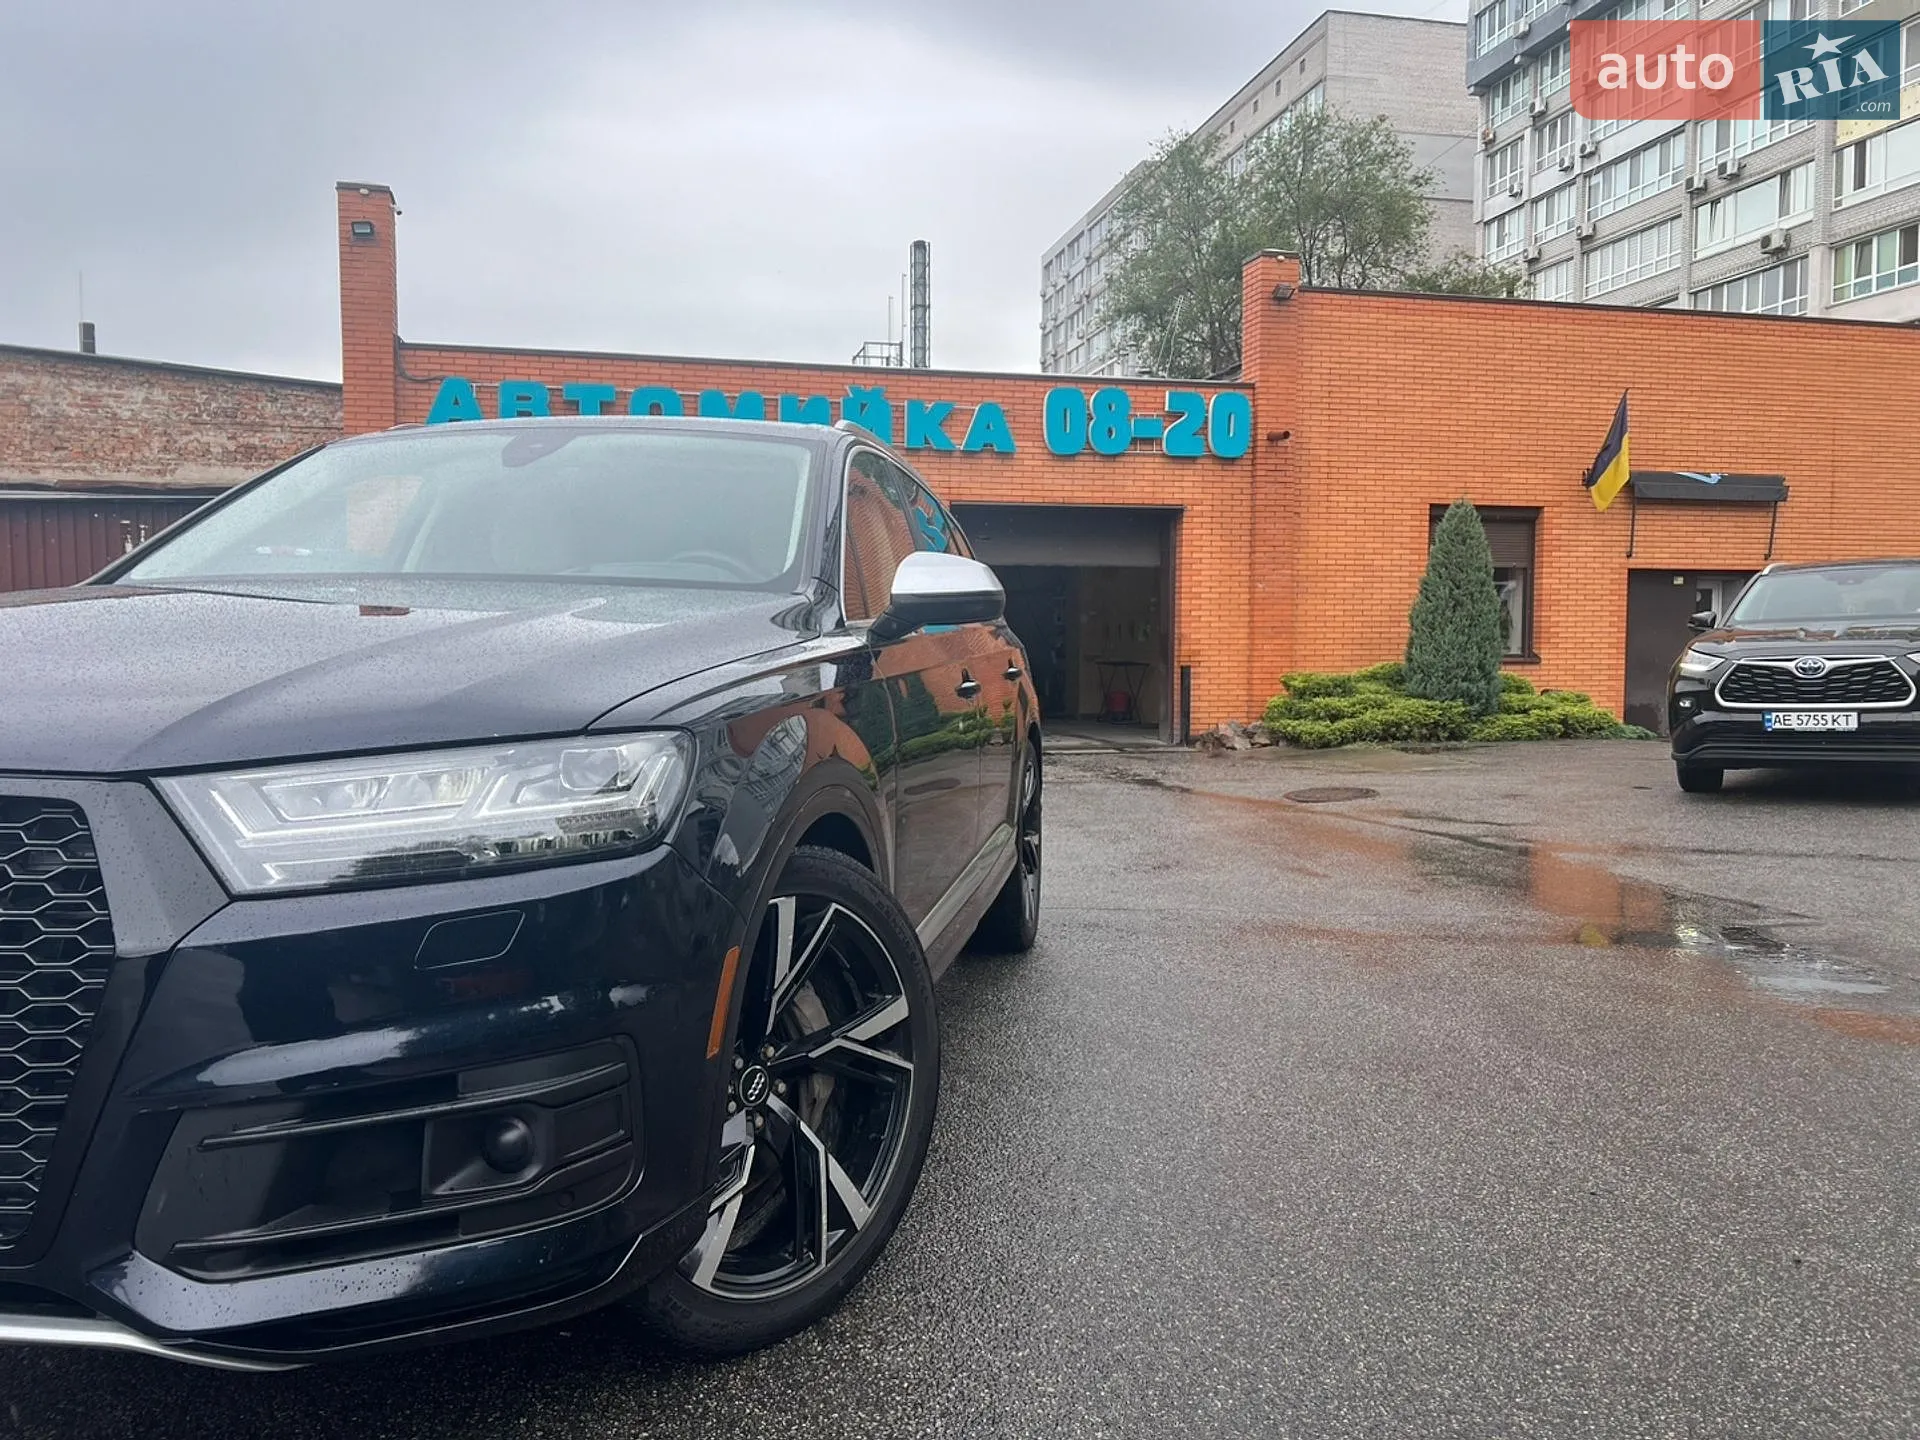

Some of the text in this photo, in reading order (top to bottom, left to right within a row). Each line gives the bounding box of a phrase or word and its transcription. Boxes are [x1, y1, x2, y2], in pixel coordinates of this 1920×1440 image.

[1043, 386, 1252, 459] 08-20
[1773, 714, 1793, 727] AE
[1796, 714, 1828, 727] 5755
[1831, 714, 1852, 727] KT
